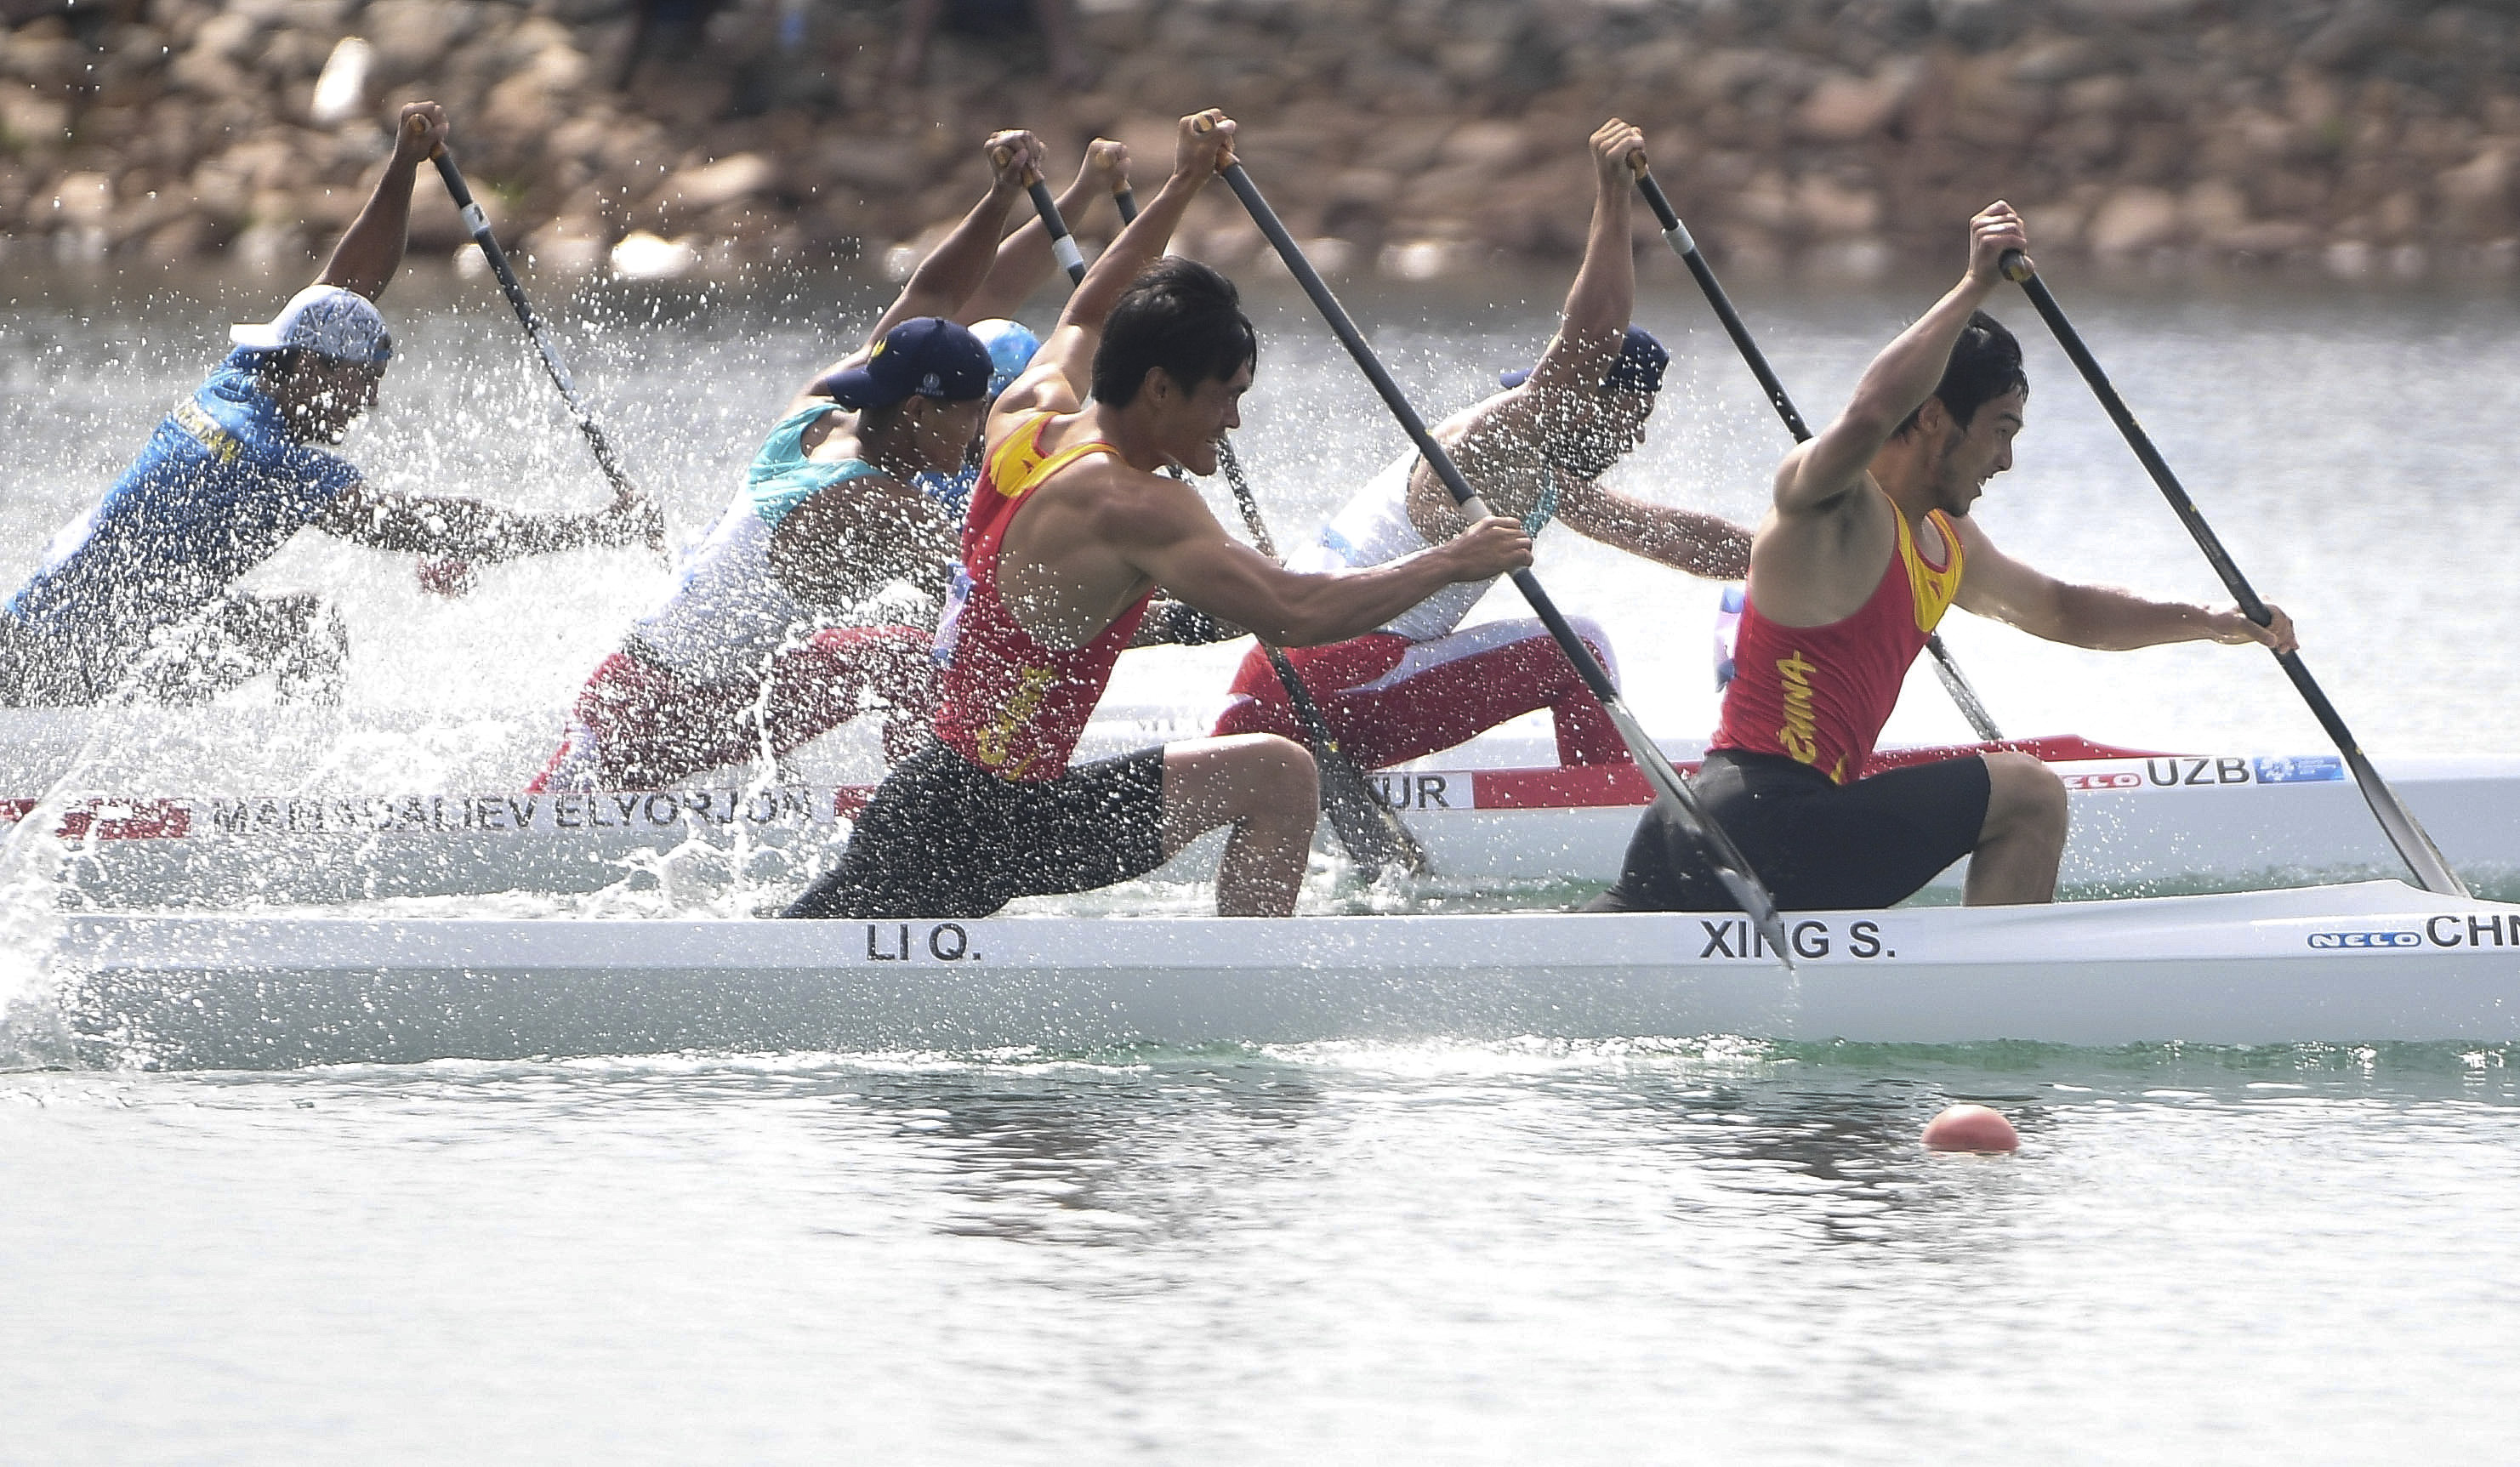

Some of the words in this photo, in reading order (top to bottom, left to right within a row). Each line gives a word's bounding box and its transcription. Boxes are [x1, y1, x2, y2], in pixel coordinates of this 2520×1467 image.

[1776, 650, 1817, 764] CHINA
[2065, 774, 2142, 789] ELO
[2147, 758, 2250, 786] UZB
[867, 924, 909, 960] LI
[929, 922, 981, 961] Q.
[1848, 919, 1896, 958] S.
[2309, 933, 2421, 947] NELO
